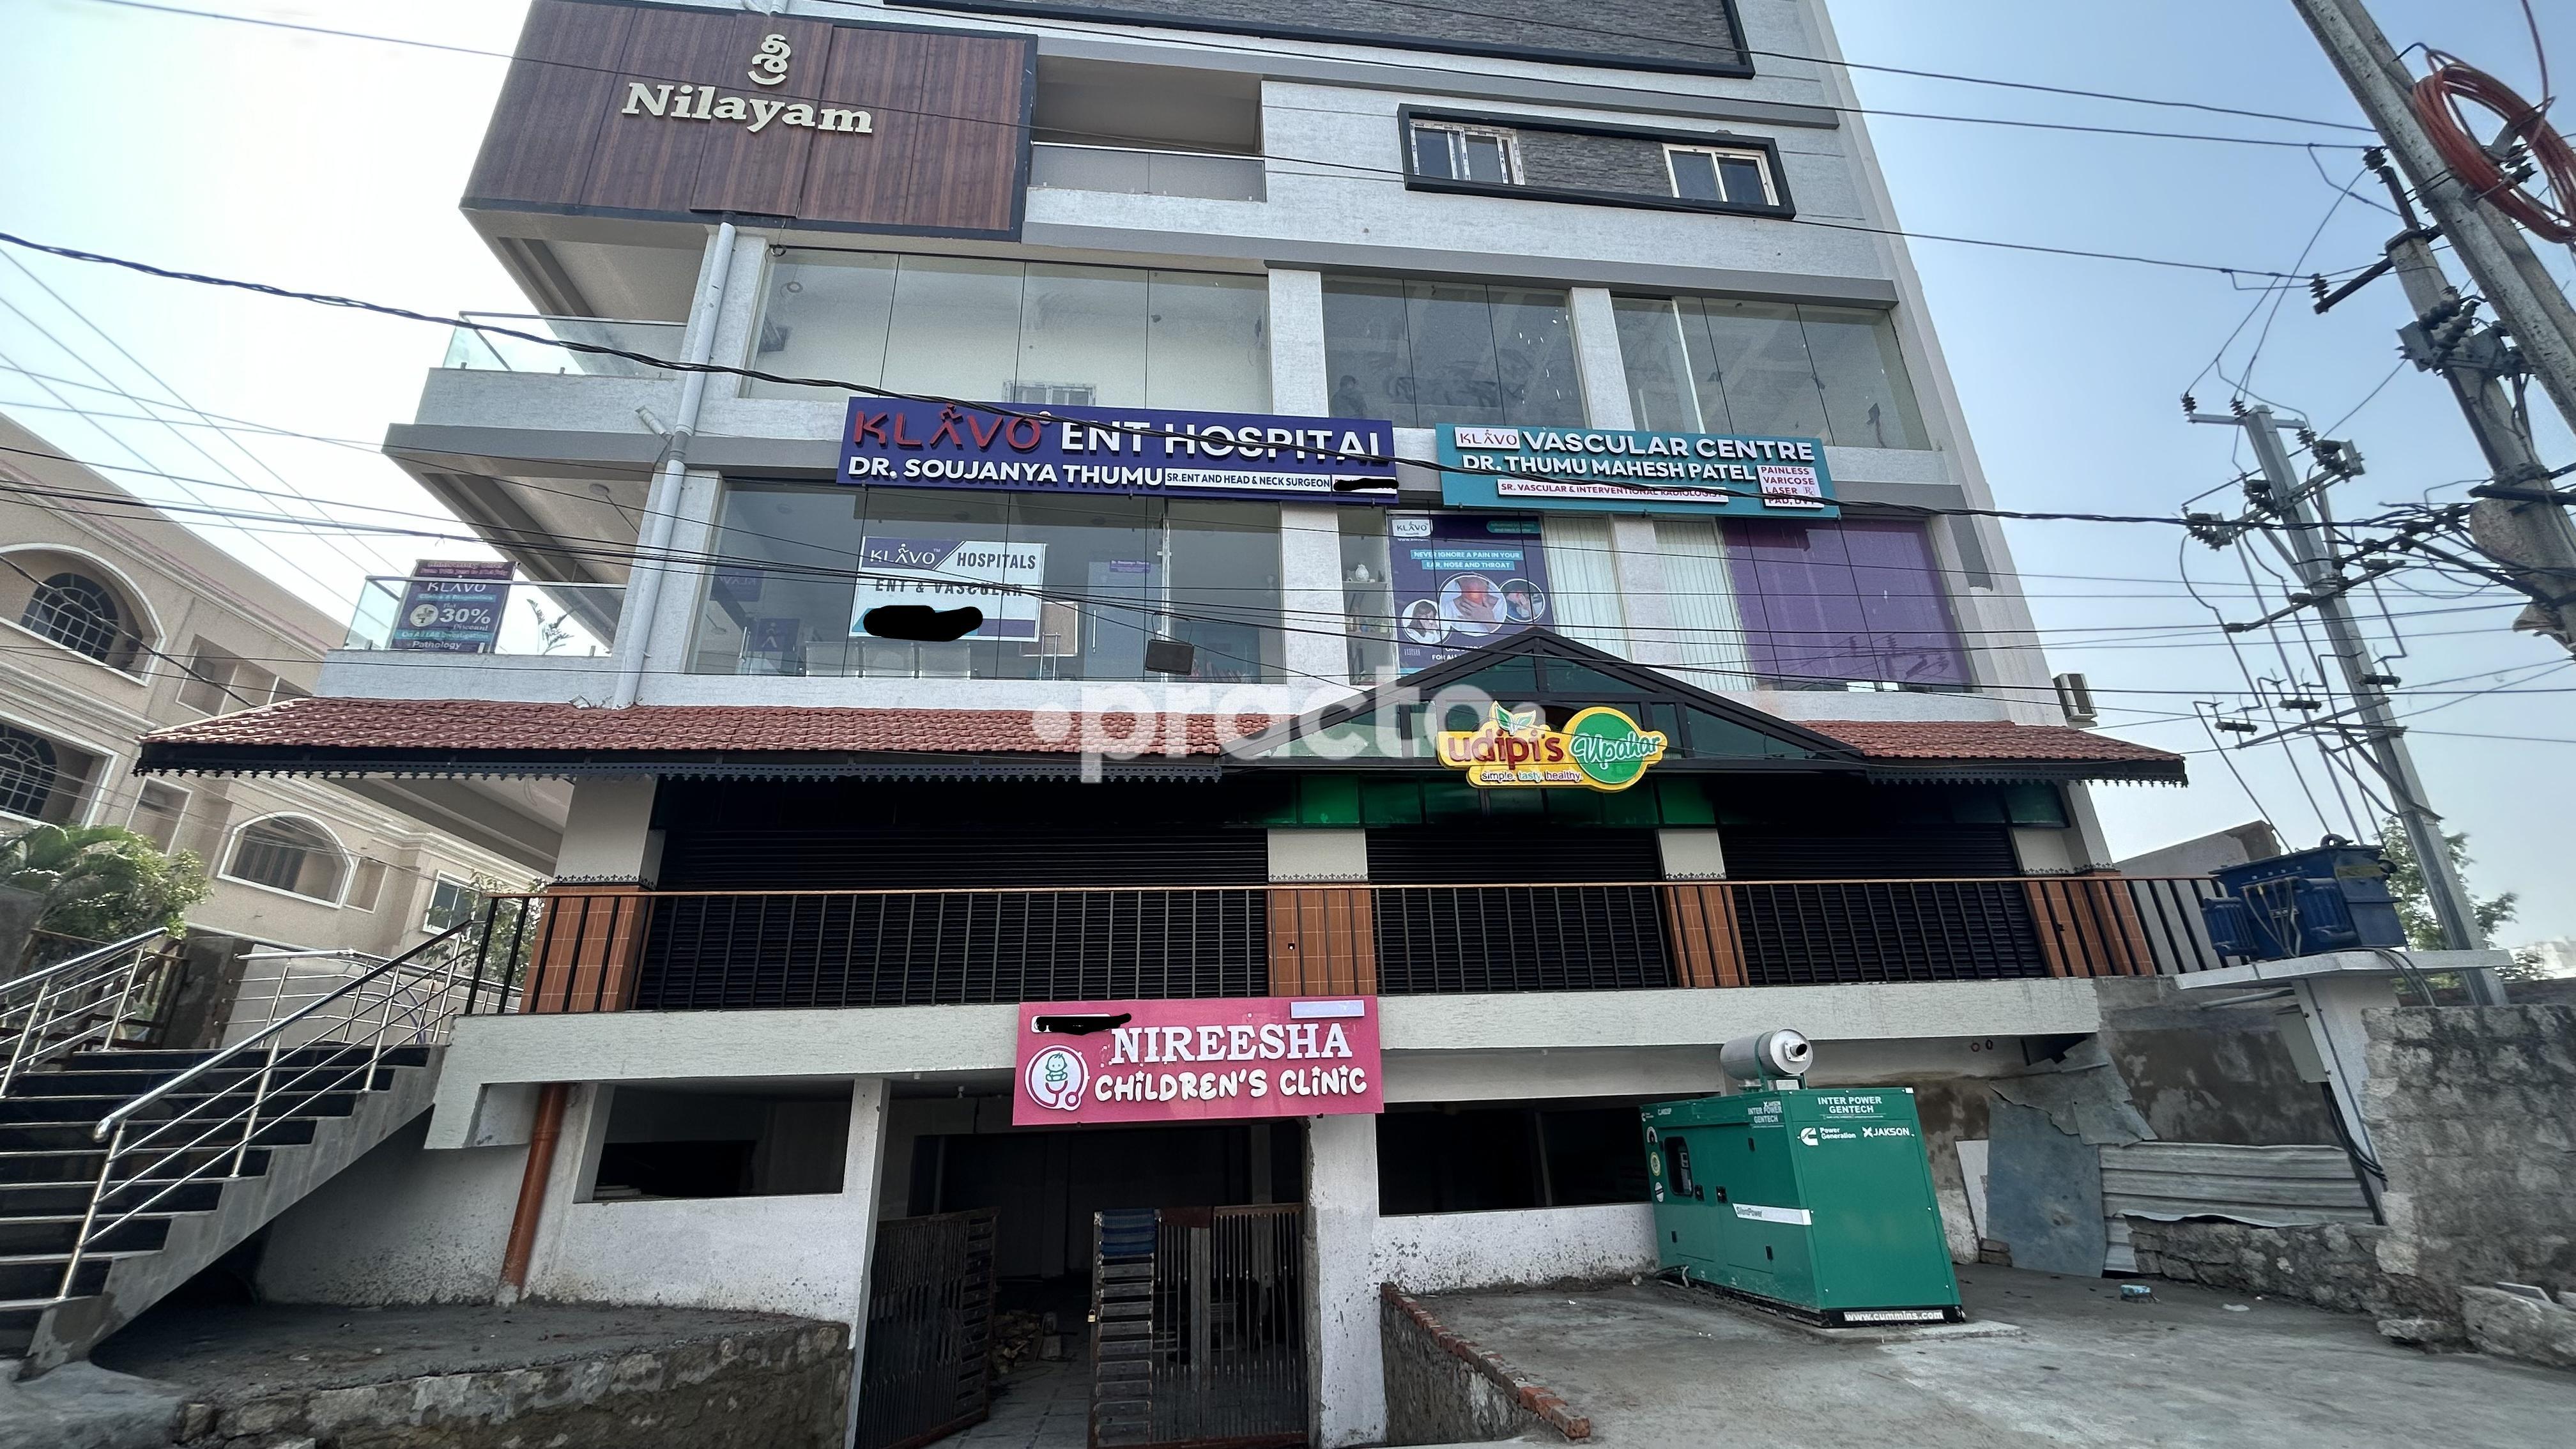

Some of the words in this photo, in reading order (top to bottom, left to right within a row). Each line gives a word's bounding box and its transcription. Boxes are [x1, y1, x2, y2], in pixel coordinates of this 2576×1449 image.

[621, 82, 873, 133] Nilayam
[854, 402, 1041, 450] KLAVO
[1062, 421, 1150, 452] ENT
[1460, 429, 1517, 445] KLAVO
[1522, 431, 1689, 456] VASCULAR
[1696, 439, 1815, 461] CENTRE
[848, 456, 898, 479] DR.
[903, 458, 1058, 482] SOUJANYA
[1062, 464, 1163, 486] THUMU
[1463, 455, 1502, 470] DR.
[1505, 456, 1587, 475] THUMU
[1591, 459, 1685, 478] MAHESH
[1688, 463, 1756, 480] PATEL
[1761, 466, 1809, 475] PAINLESS
[1202, 474, 1222, 484] AND
[1224, 475, 1250, 484] HEAD
[1252, 476, 1258, 484] &
[1259, 476, 1284, 486] NECK
[1286, 477, 1330, 488] SURGEON
[1763, 477, 1814, 485] VARICOSE
[1517, 484, 1567, 493] VASCULAR
[1577, 486, 1658, 495] INTERVENTIONAL
[1397, 521, 1427, 531] KLAVO
[870, 543, 935, 564] KLAVO
[957, 553, 1036, 569] HOSPITALS
[426, 582, 486, 593] KLAVO
[875, 578, 907, 592] ENT
[916, 582, 924, 592] &
[934, 582, 1022, 596] VASCULAR
[440, 609, 491, 624] 30%
[453, 624, 488, 632] Discount
[412, 641, 462, 650] Pathology
[1448, 729, 1564, 770] udipi's
[1481, 770, 1516, 781] simple.
[1545, 770, 1583, 782] healthy.
[1109, 1023, 1353, 1064] NIREESHA
[1848, 1096, 1882, 1105] POWER
[1747, 1107, 1763, 1115] INTER
[1763, 1106, 1782, 1114] POWER
[1828, 1105, 1874, 1114] GENTECH
[1754, 1115, 1778, 1123] GENTECH
[1873, 1127, 1910, 1136] JAKSON
[1844, 1310, 1944, 1321] www.cummins.com
